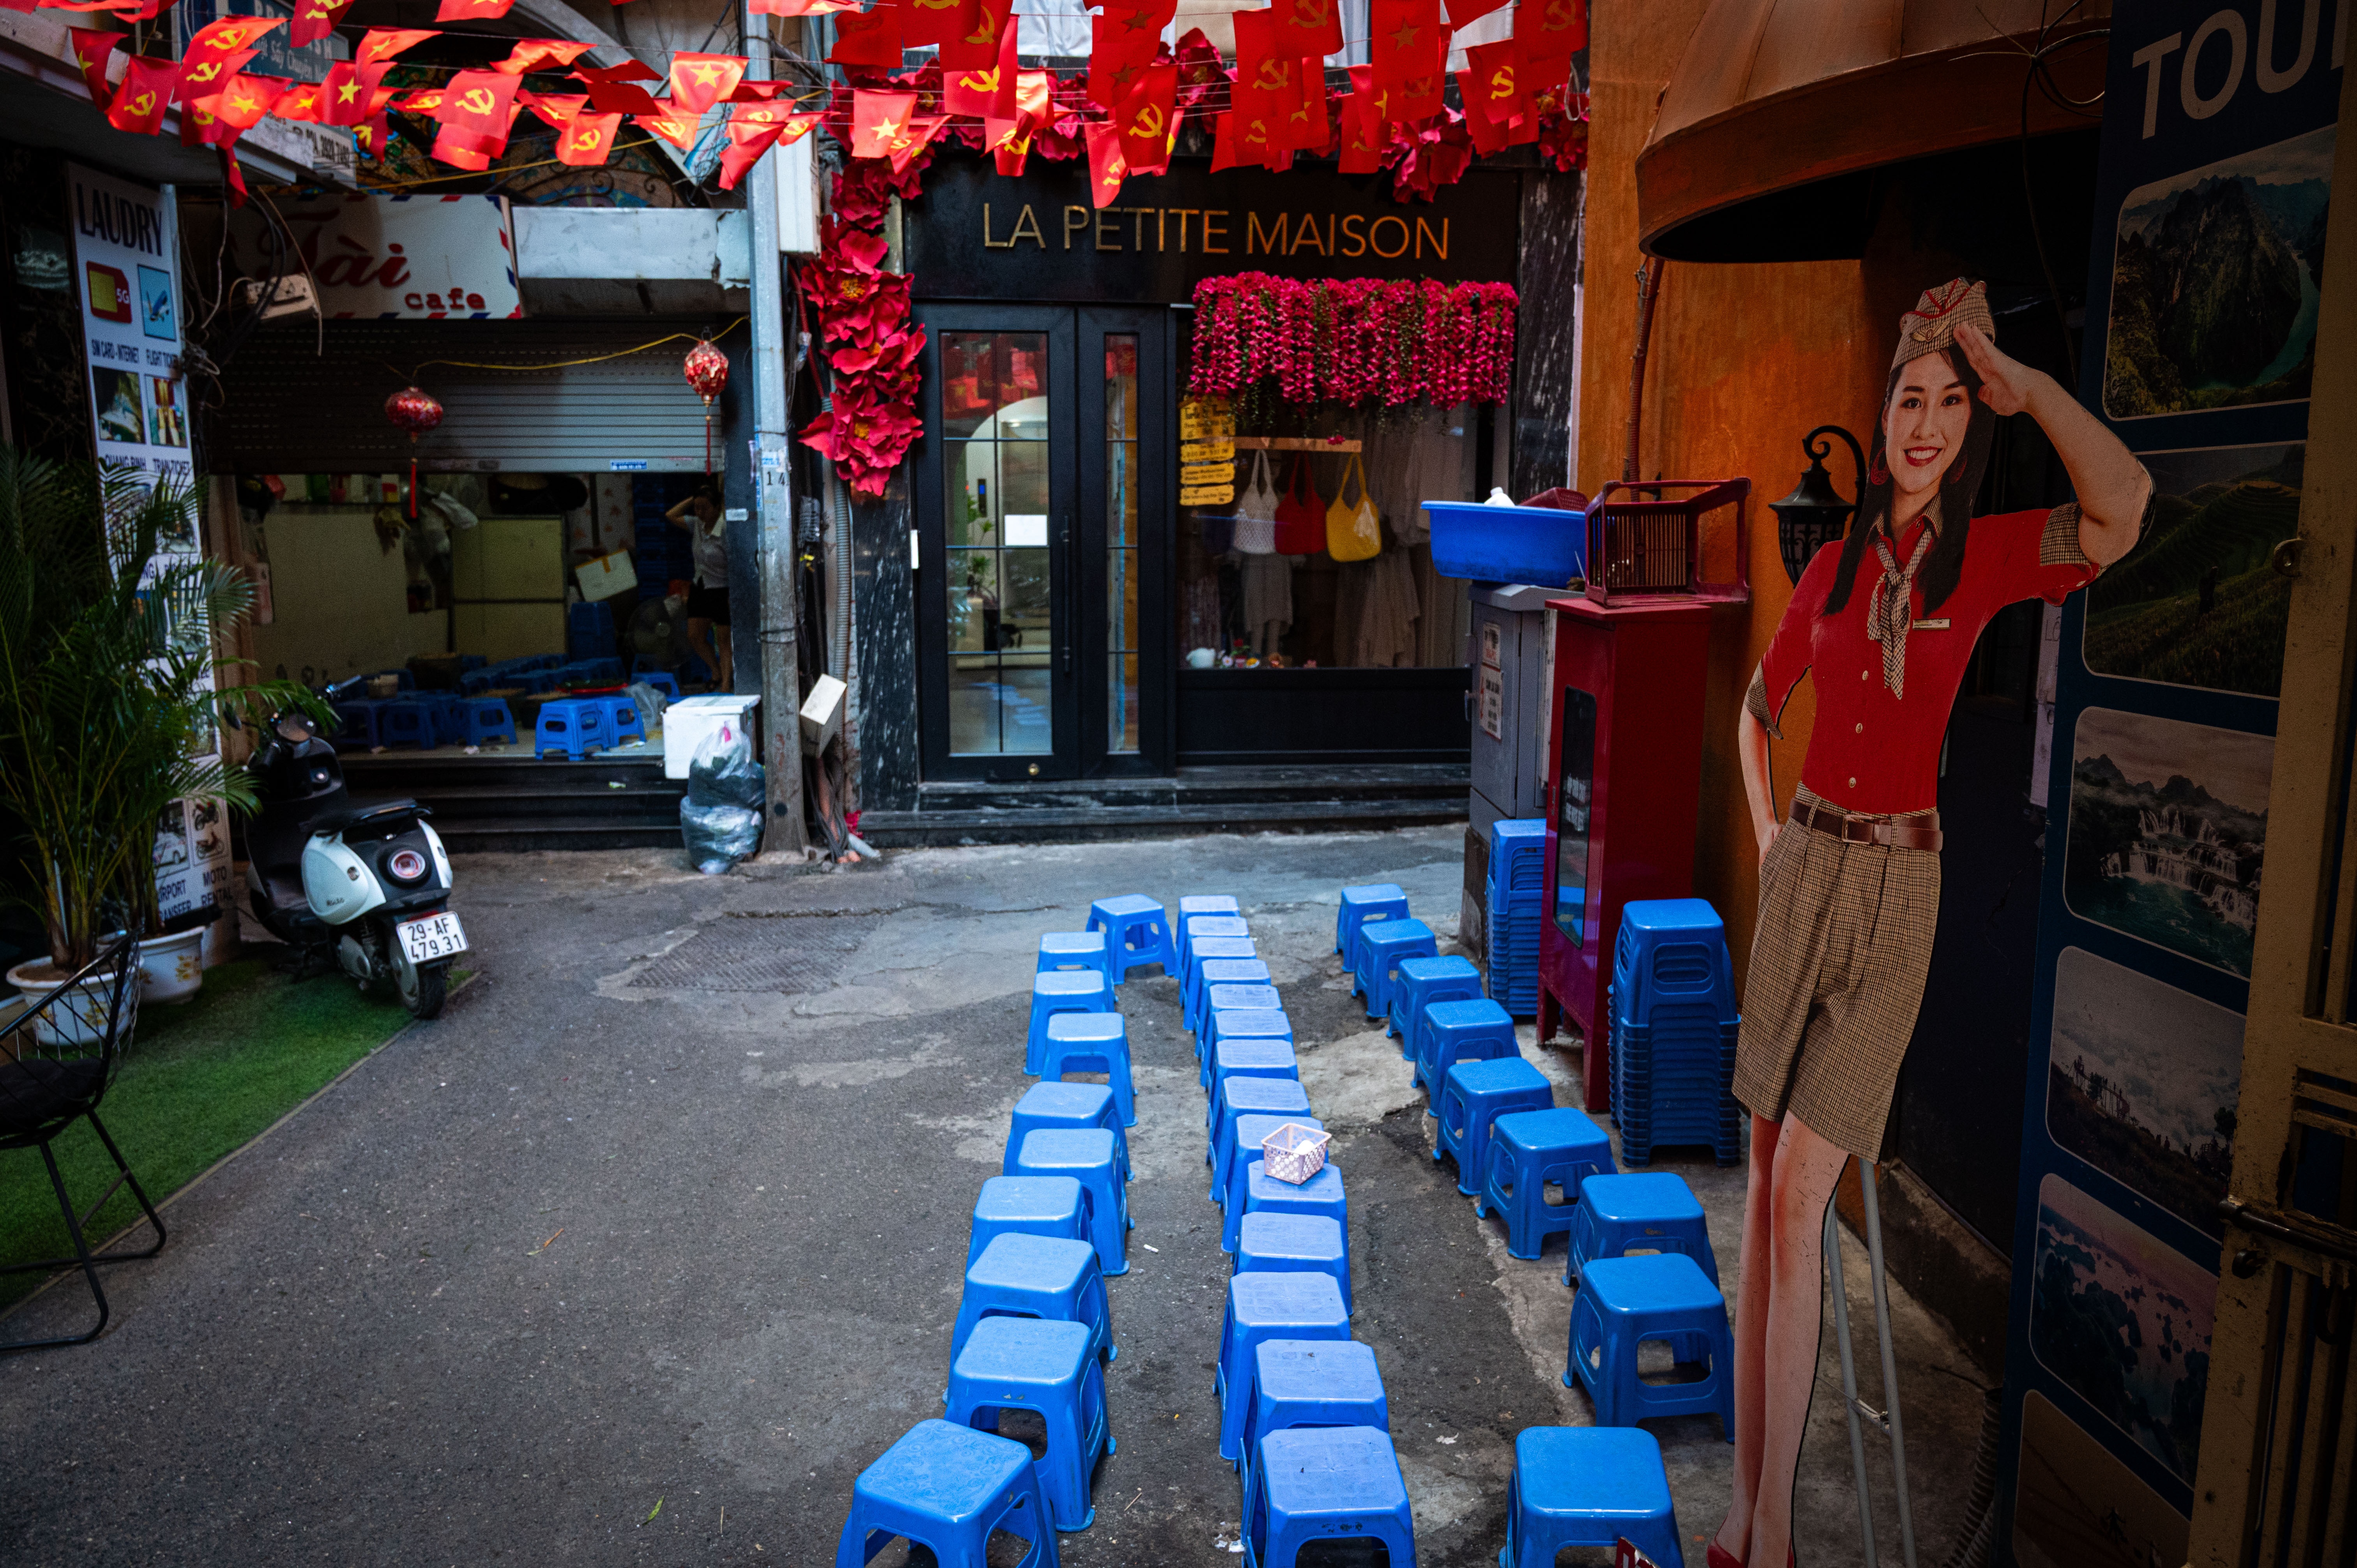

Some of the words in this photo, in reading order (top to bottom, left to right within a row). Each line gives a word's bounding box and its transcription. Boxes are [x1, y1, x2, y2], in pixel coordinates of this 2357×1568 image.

[76, 183, 162, 256] LAUDRY
[983, 203, 1047, 250] LA
[1063, 205, 1230, 254] PETITE
[1246, 211, 1450, 261] MAISON
[117, 288, 129, 304] 5G
[405, 288, 486, 310] cafe
[203, 866, 227, 887] MOTO
[408, 917, 449, 942] 29-AF
[410, 934, 463, 960] 479.31
